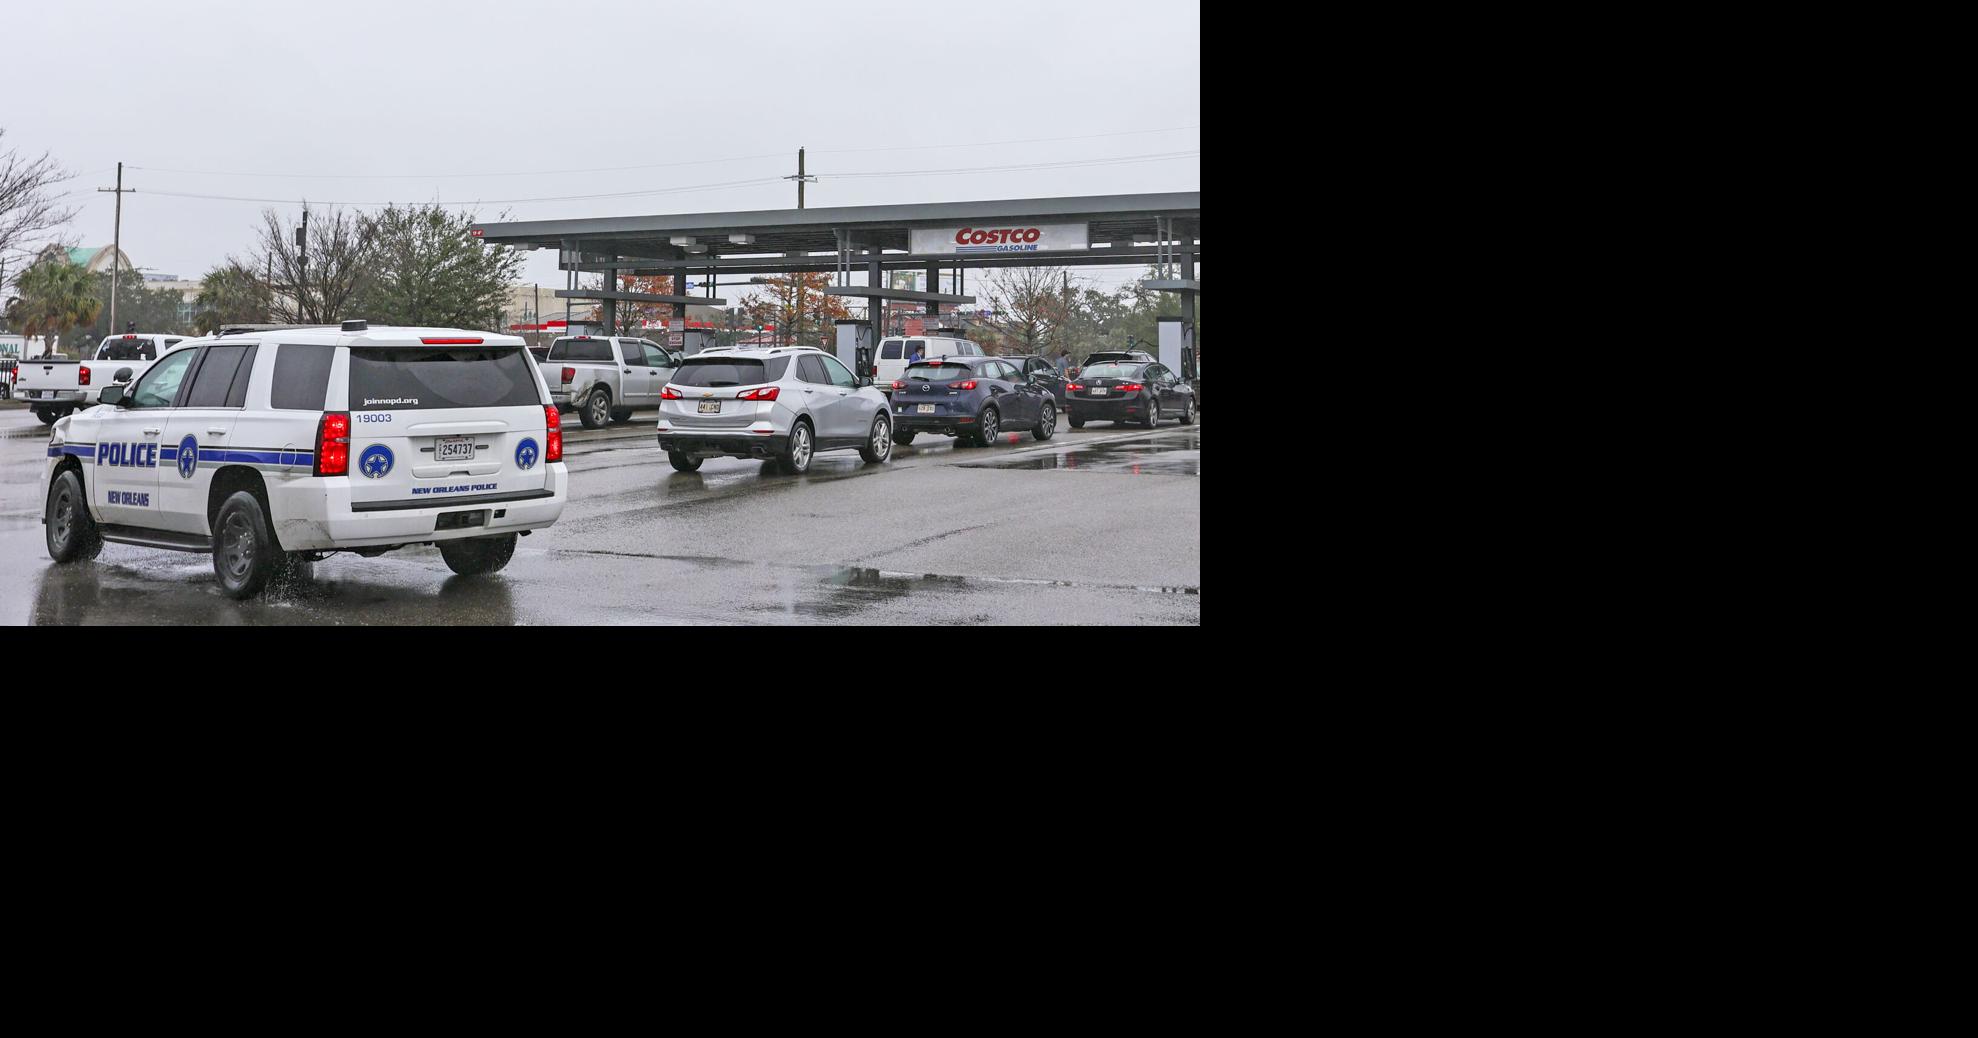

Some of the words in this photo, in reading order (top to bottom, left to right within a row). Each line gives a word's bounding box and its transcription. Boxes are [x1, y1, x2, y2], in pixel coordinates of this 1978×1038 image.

[955, 227, 1040, 245] COSTCO
[996, 244, 1038, 252] GASOLINE
[363, 397, 419, 406] joinnopd.org
[356, 413, 392, 423] 19003
[97, 442, 157, 468] POLICE
[442, 443, 473, 456] 254737
[412, 487, 431, 495] NEW
[432, 484, 470, 494] ORLEANS
[471, 483, 498, 492] POLICE
[108, 490, 121, 504] NEW
[121, 491, 149, 507] ORLEANS
